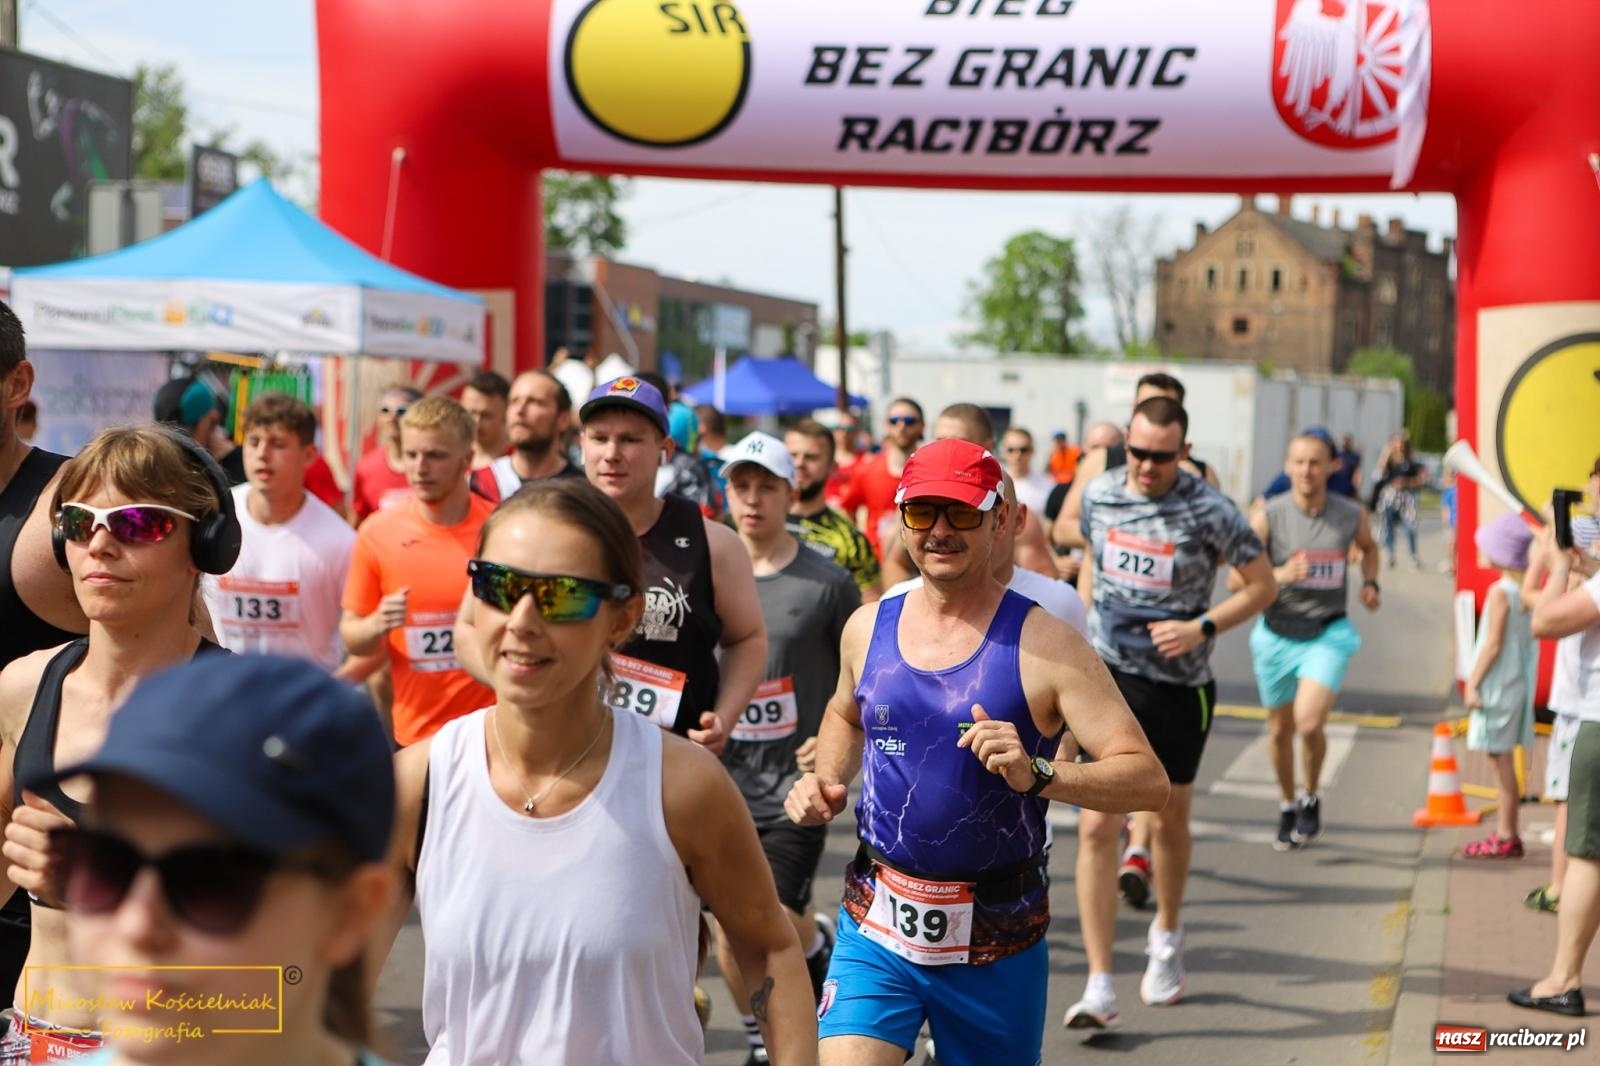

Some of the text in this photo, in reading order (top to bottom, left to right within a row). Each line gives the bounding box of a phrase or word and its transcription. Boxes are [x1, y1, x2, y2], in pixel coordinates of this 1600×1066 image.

[804, 46, 1197, 88] BEZ GRANIC
[1119, 552, 1154, 576] 212
[235, 597, 281, 620] 133
[738, 701, 781, 725] 09
[907, 880, 925, 892] BEZ
[924, 884, 961, 895] GRANIC
[889, 895, 948, 943] 139
